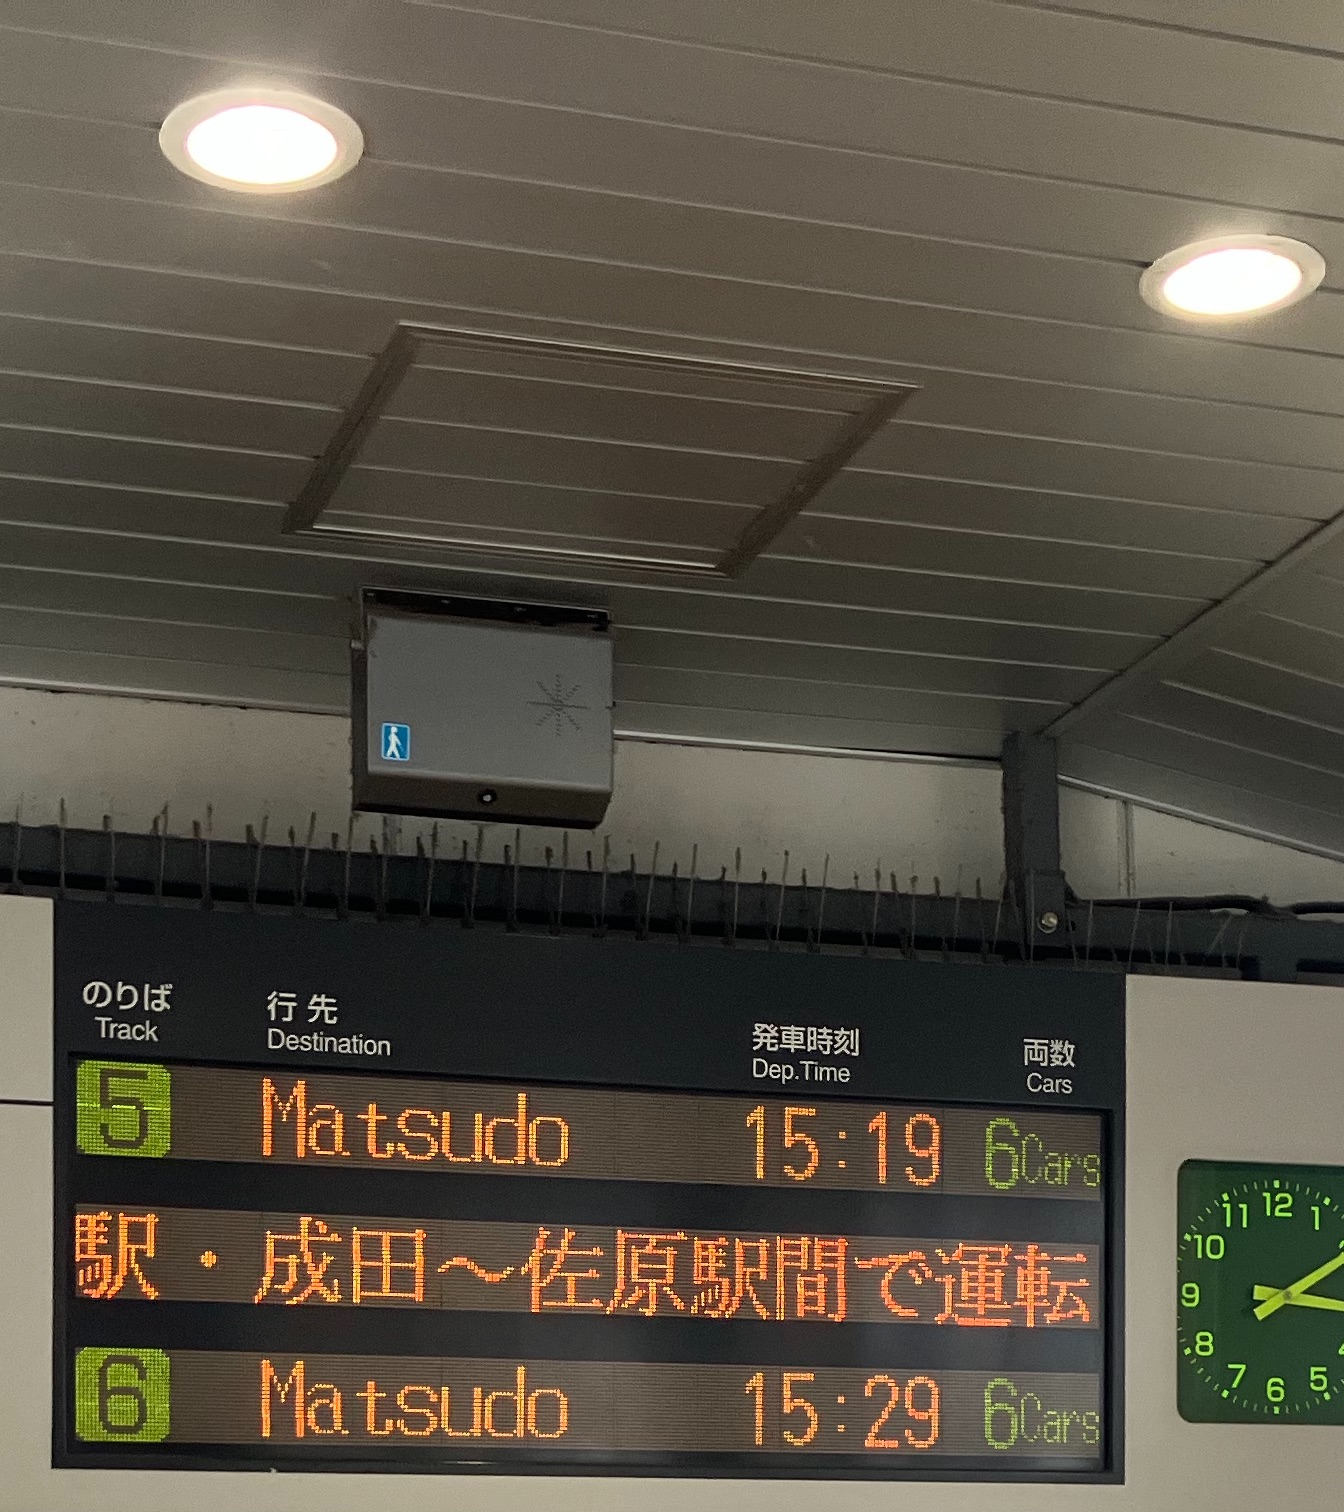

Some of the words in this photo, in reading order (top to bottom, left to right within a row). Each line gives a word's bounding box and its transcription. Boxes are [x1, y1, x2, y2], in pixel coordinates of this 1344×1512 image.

[82, 980, 173, 1012] のりば
[94, 1016, 158, 1042] Track
[267, 1027, 391, 1056] Destination
[752, 1023, 860, 1056] 発車時刻
[1023, 1038, 1076, 1068] 両数
[1026, 1072, 1073, 1094] Cars
[97, 1069, 150, 1150] 5
[260, 1076, 570, 1167] Matsudo
[745, 1103, 943, 1187] 15:19
[1222, 1203, 1248, 1228] 11
[1262, 1192, 1293, 1217] 12
[1311, 1206, 1320, 1231] 1
[1194, 1234, 1225, 1259] 10
[1181, 1283, 1200, 1307] 9
[1195, 1331, 1213, 1356] 8
[1227, 1363, 1246, 1388] 7
[1310, 1366, 1328, 1391] 5
[97, 1352, 148, 1435] 6
[260, 1358, 569, 1440] Matsudo
[743, 1370, 942, 1449] 15:29
[1267, 1378, 1285, 1402] 6
